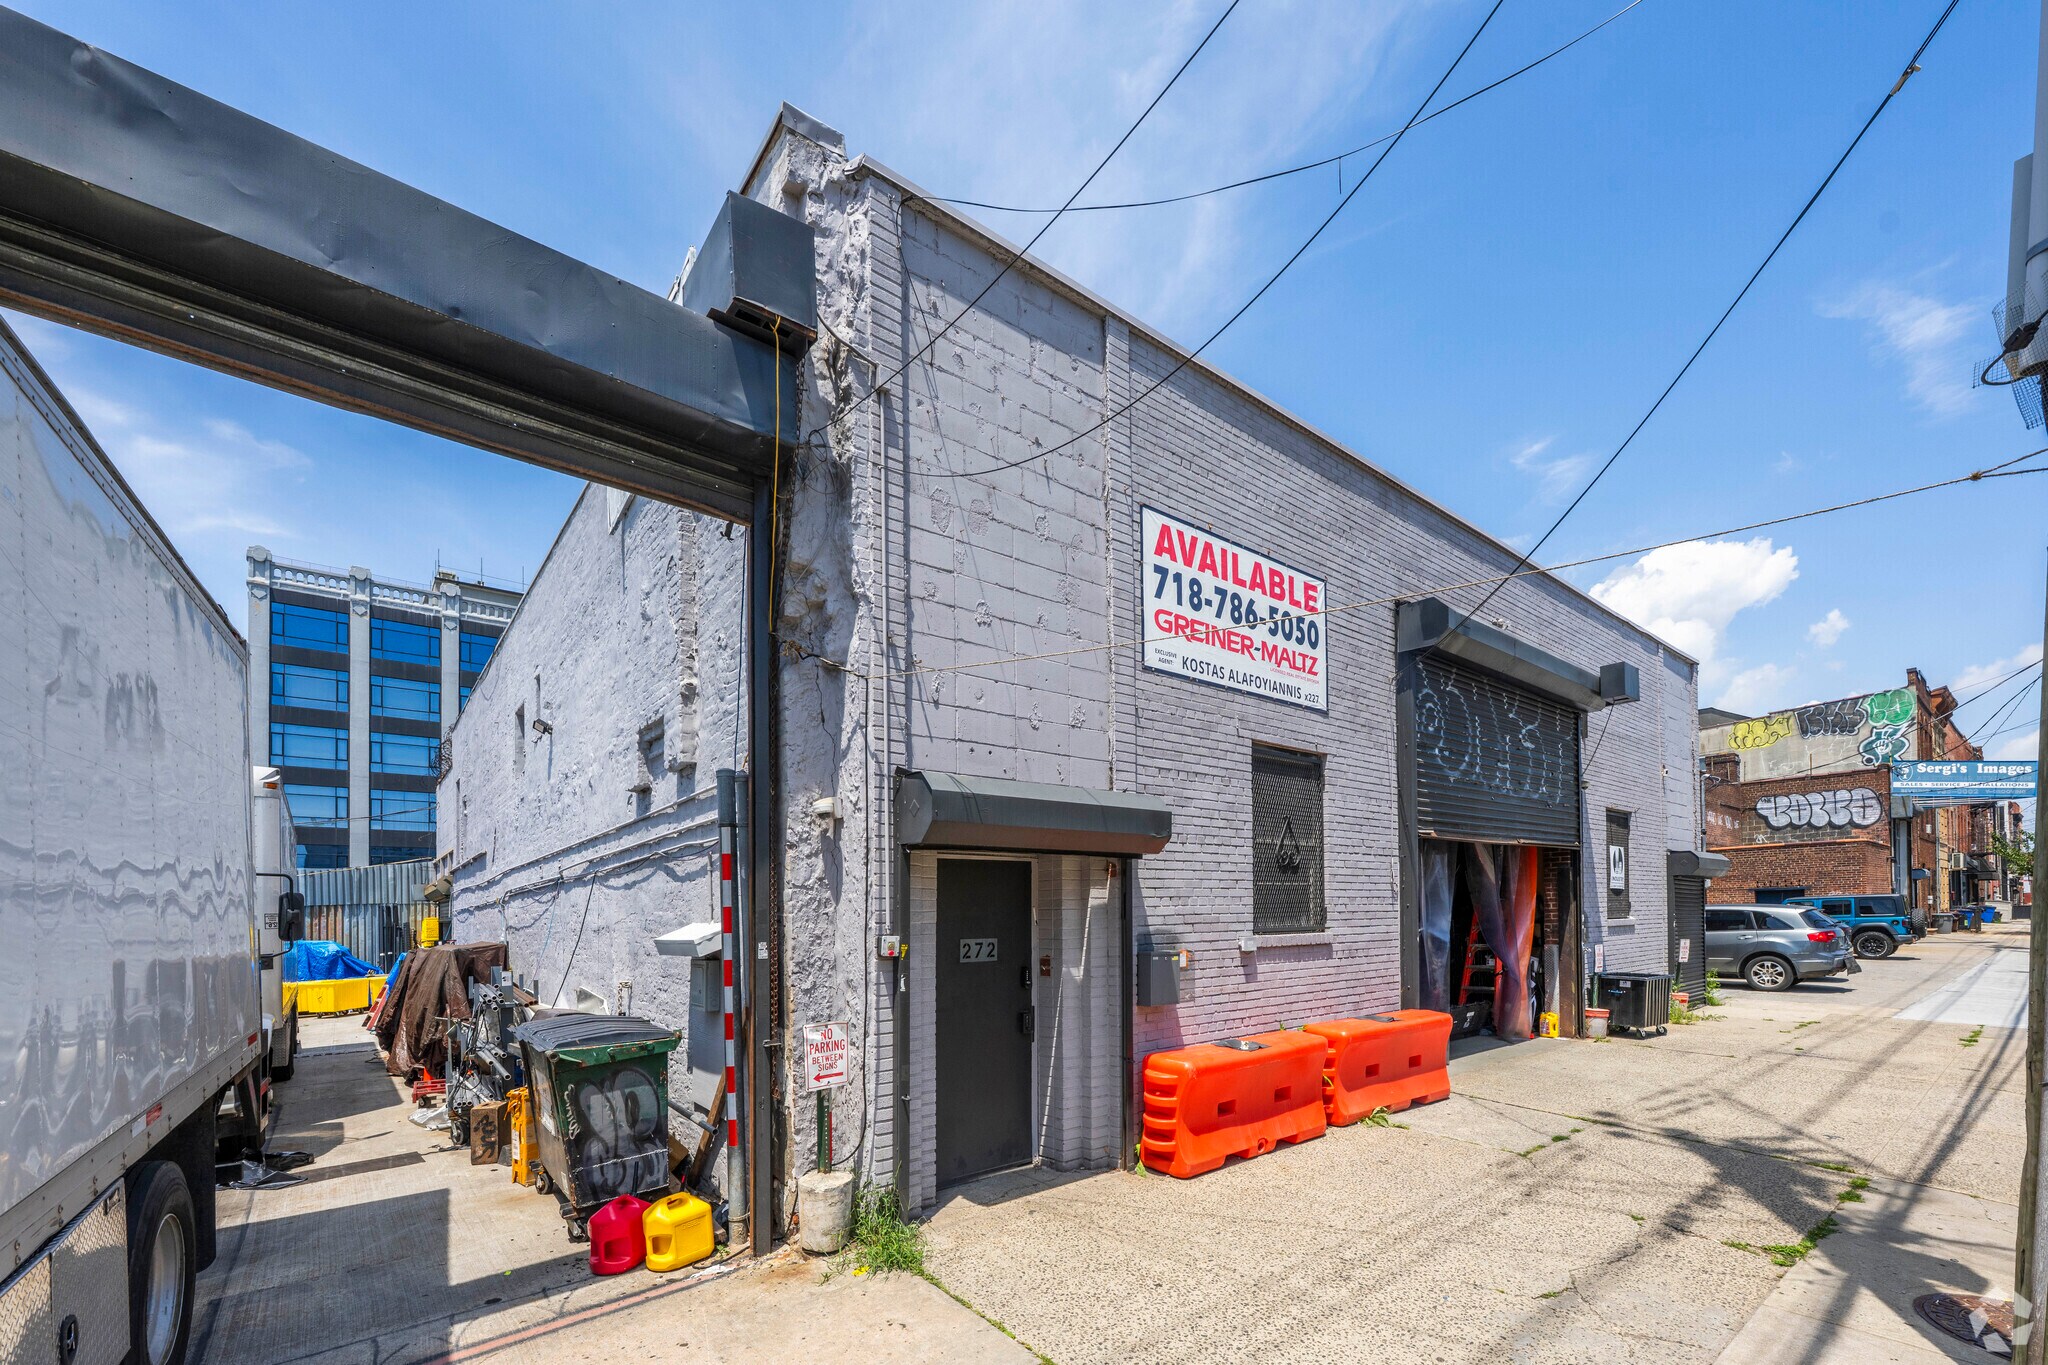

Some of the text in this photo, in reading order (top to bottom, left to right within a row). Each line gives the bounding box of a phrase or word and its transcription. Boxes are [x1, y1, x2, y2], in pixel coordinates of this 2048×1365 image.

[1154, 523, 1319, 613] AVAILABLE
[1153, 563, 1320, 650] 718-786-5050
[1153, 608, 1319, 677] GREINER-MALTZ
[1154, 647, 1177, 659] EXCLUSIVE
[1158, 657, 1174, 666] AGENT:
[1182, 655, 1319, 704] KOSTAS ALAFOYIANNIS x227
[1916, 763, 2033, 776] Sergi's Images
[962, 941, 996, 960] 272
[820, 1028, 833, 1040] NO
[809, 1039, 846, 1056] PARKING
[811, 1052, 844, 1066] BETWEEN
[817, 1061, 838, 1073] SIGNS
